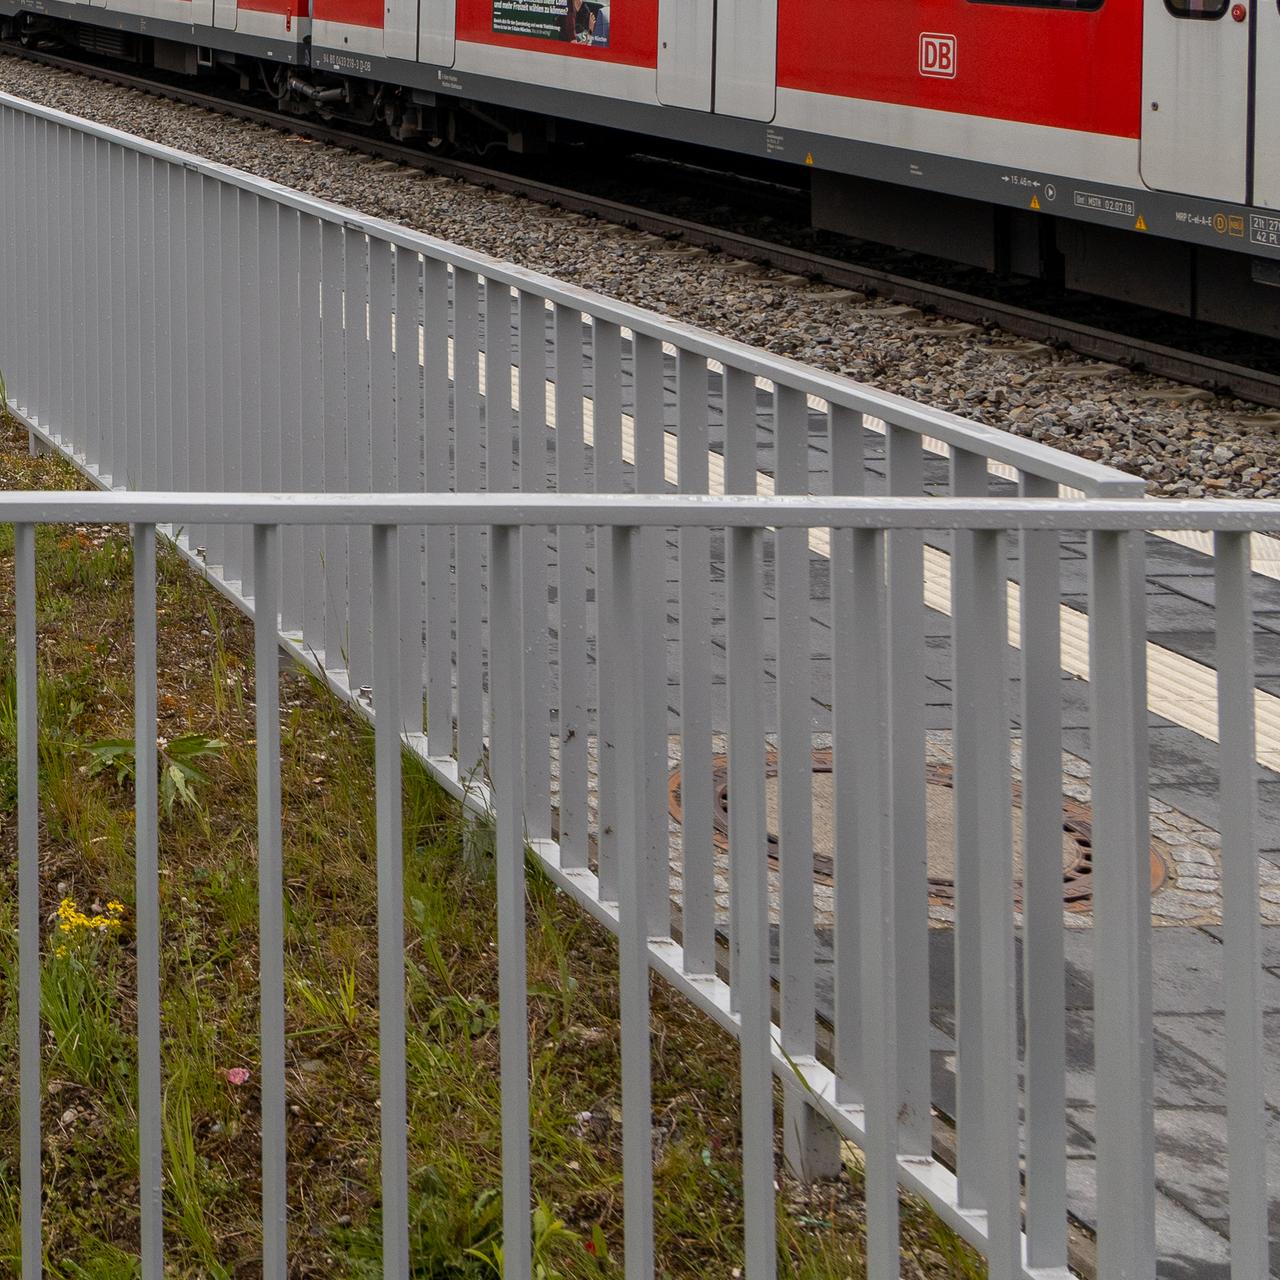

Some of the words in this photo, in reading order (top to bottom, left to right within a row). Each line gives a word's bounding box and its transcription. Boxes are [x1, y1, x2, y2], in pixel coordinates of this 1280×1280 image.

[923, 39, 952, 70] DB
[1105, 199, 1132, 214] 02.07.18
[1256, 231, 1266, 242] 42
